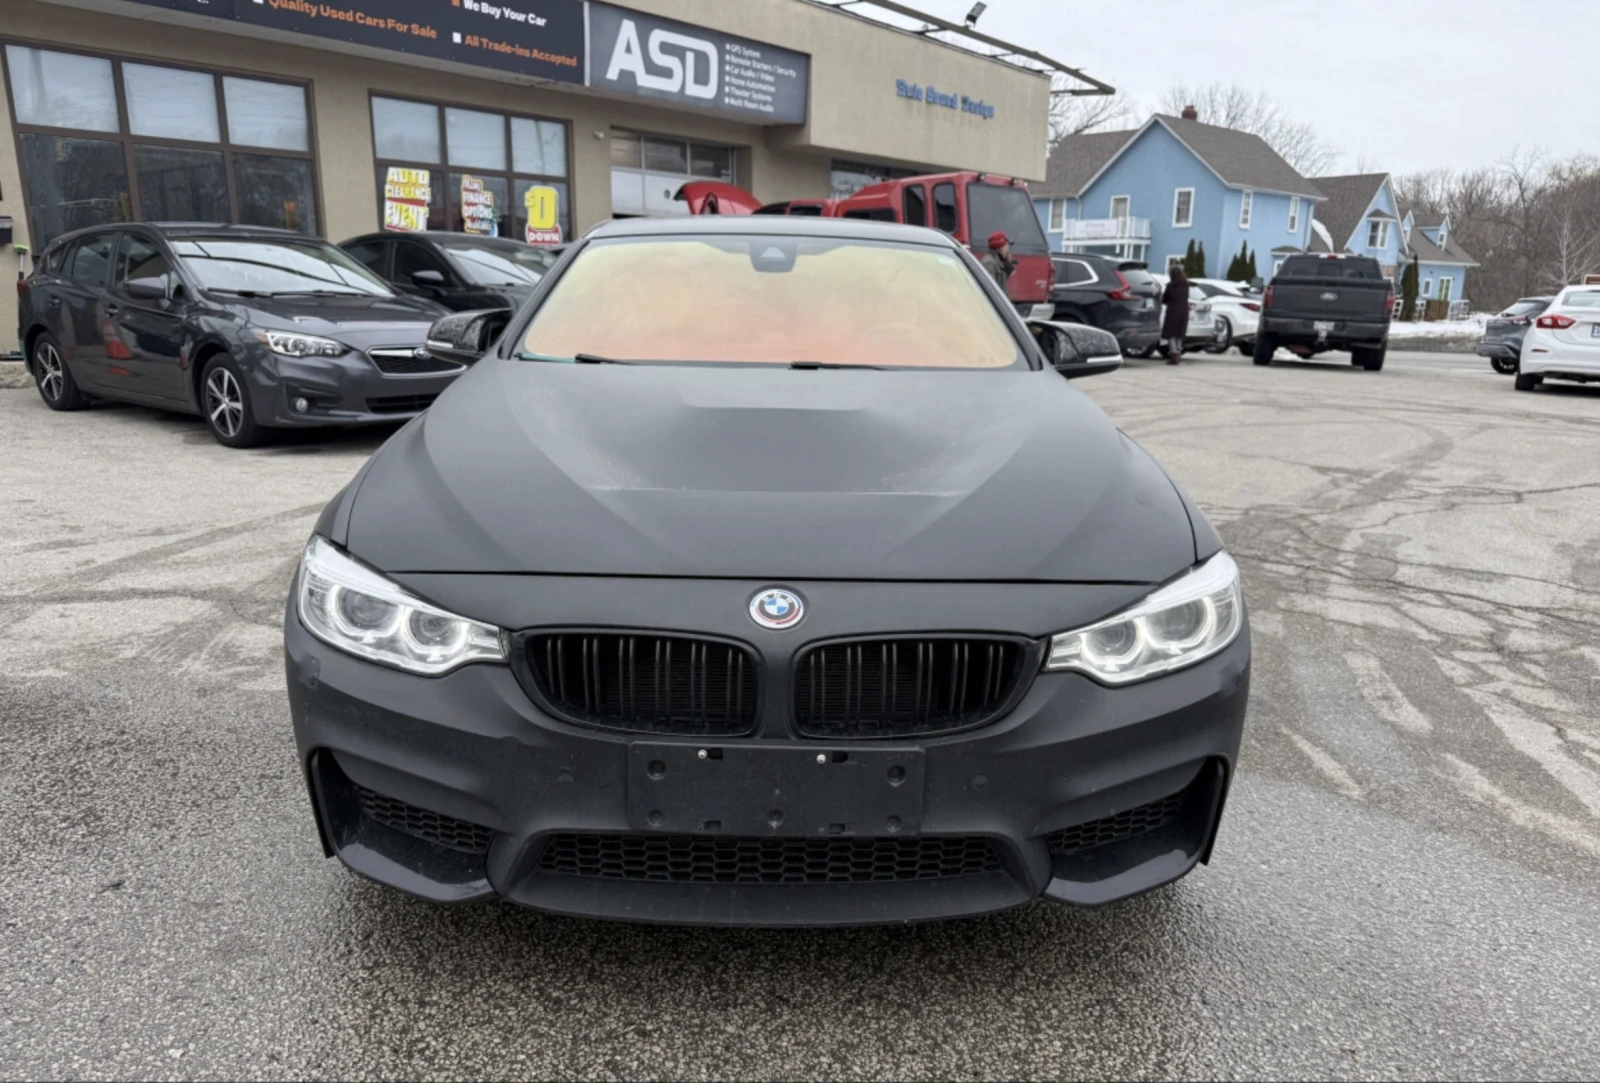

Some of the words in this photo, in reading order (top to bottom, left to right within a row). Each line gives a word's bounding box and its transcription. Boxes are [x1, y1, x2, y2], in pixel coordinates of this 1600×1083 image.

[269, 0, 317, 17] Quality
[320, 4, 353, 22] Used
[355, 12, 385, 28] Cars
[387, 18, 408, 33] For
[411, 23, 437, 39] Sale
[463, 0, 480, 11] We
[480, 2, 501, 19] Buy
[502, 7, 527, 22] Your
[527, 13, 547, 26] Car
[465, 35, 479, 47] All
[532, 48, 577, 66] Accepted
[606, 19, 718, 100] ASD
[731, 54, 751, 66] Remote
[776, 64, 797, 79] Security
[740, 68, 756, 78] Audio
[746, 79, 776, 93] Automation
[387, 167, 429, 185] AUTO
[385, 185, 431, 202] CLEARANCE
[463, 192, 492, 204] FINANCE
[385, 201, 430, 231] EVENT
[464, 205, 493, 219] OPTIONS
[525, 187, 558, 230] $0
[529, 232, 559, 242] DOWN
